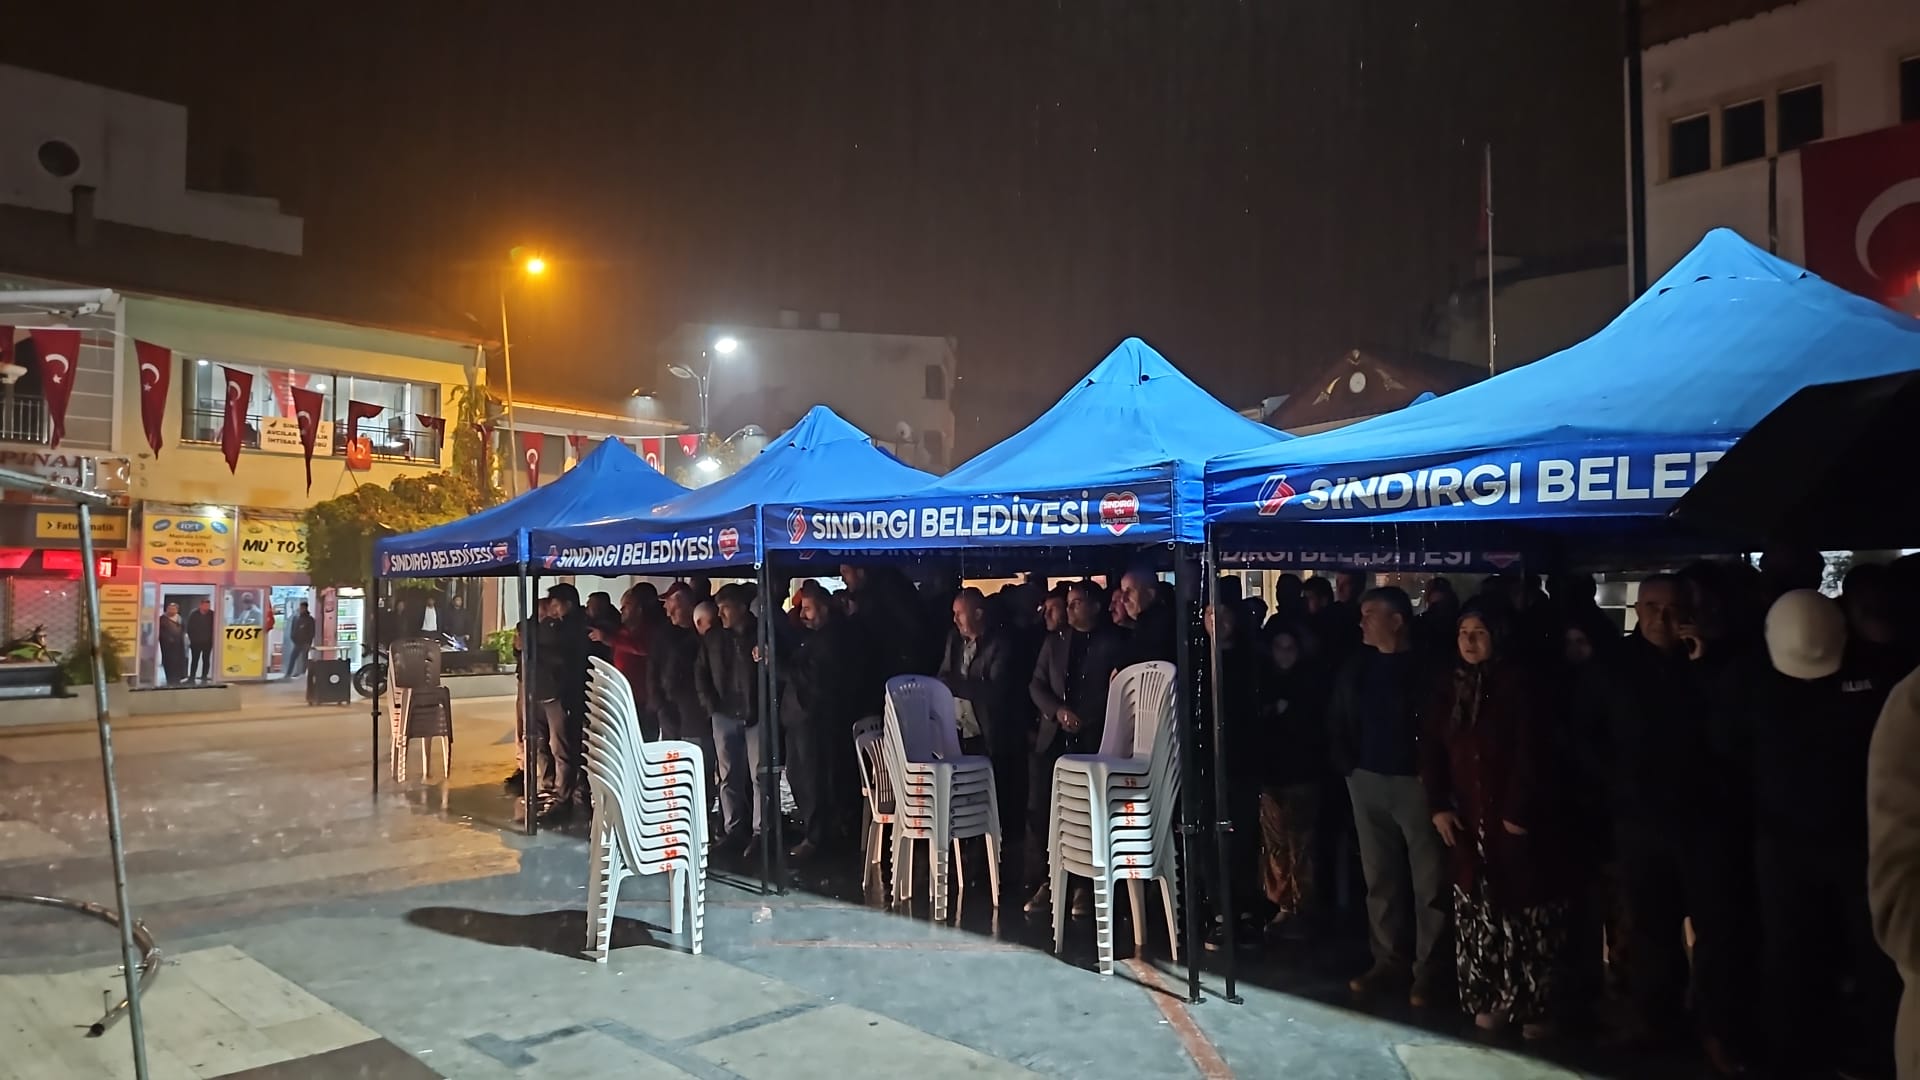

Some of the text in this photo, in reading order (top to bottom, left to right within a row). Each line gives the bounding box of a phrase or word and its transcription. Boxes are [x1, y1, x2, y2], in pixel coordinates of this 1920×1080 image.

[1302, 462, 1522, 511] SINDIRGI
[811, 490, 1089, 540] SINDIRGI BELEDİYESİ
[391, 541, 494, 572] SINDIRGI BELEDİYESİ
[557, 528, 713, 568] SINDIRGI BELEDİYESİ
[225, 628, 263, 640] TOST
